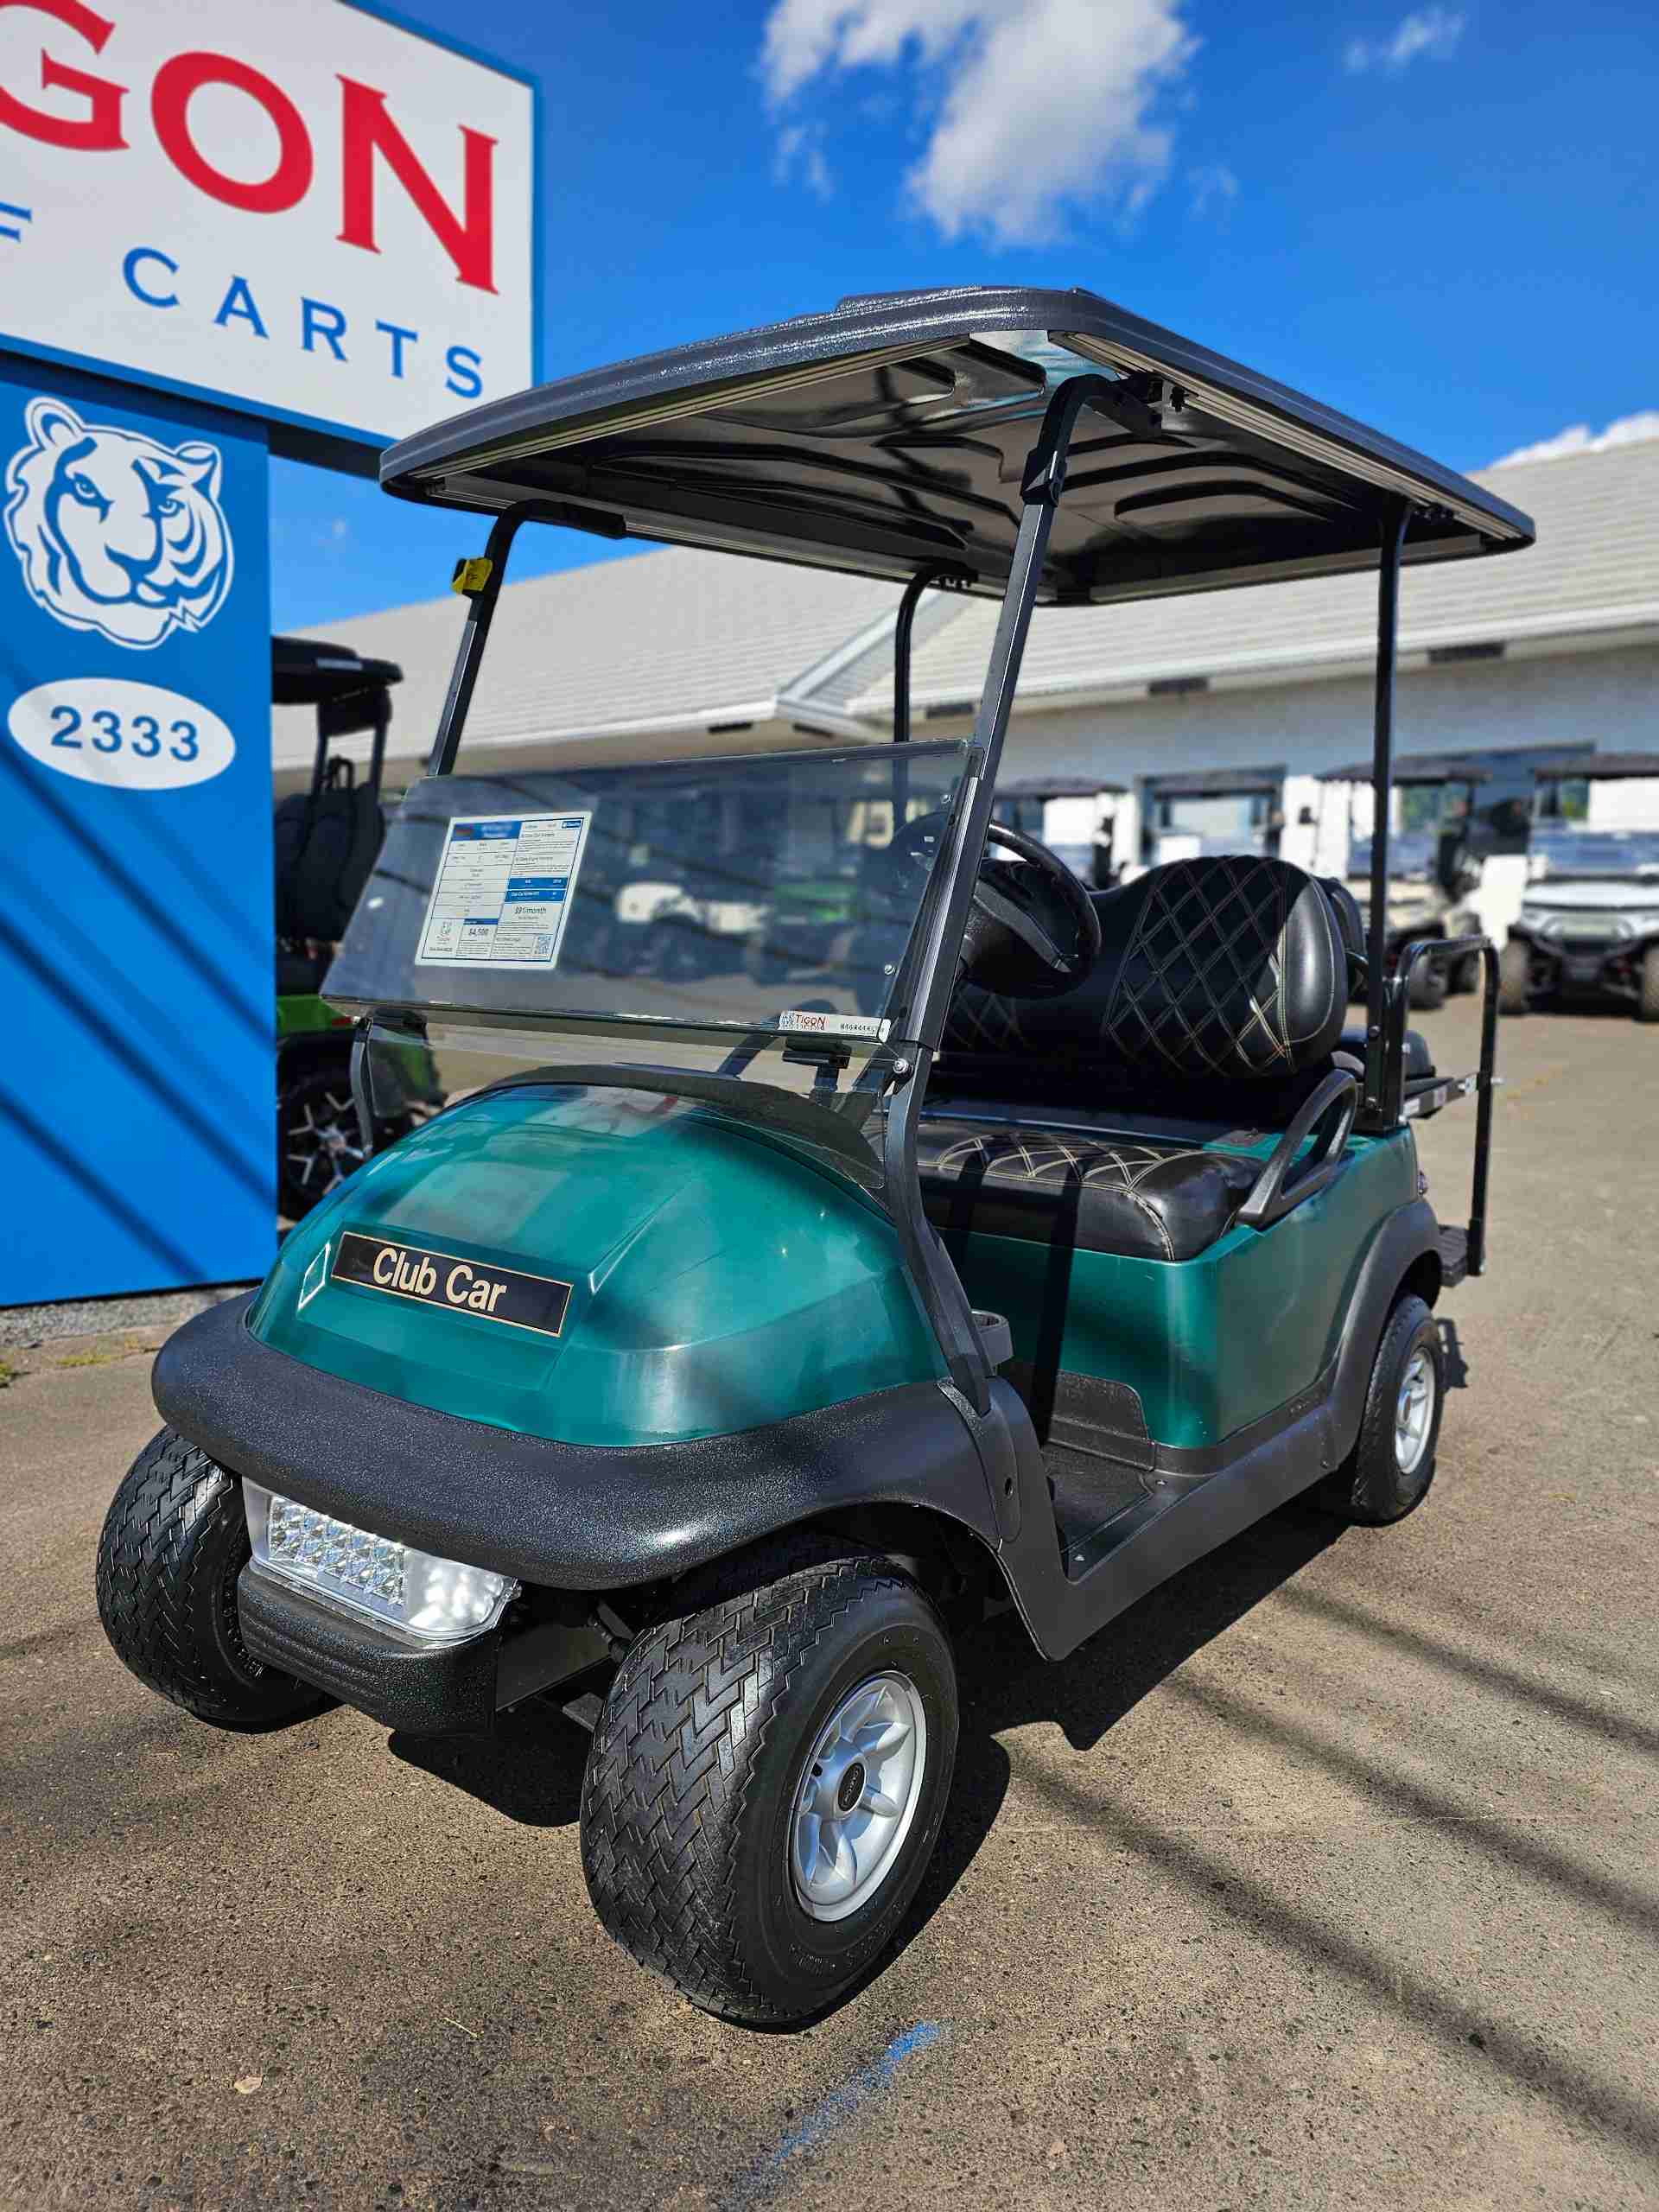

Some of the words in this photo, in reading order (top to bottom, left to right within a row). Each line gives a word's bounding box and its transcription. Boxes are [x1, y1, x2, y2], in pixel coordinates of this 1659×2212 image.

[122, 246, 484, 399] CARTS
[50, 705, 200, 762] 2333
[795, 1014, 826, 1025] TIGON
[373, 1248, 437, 1295] Club
[446, 1264, 507, 1312] Car
